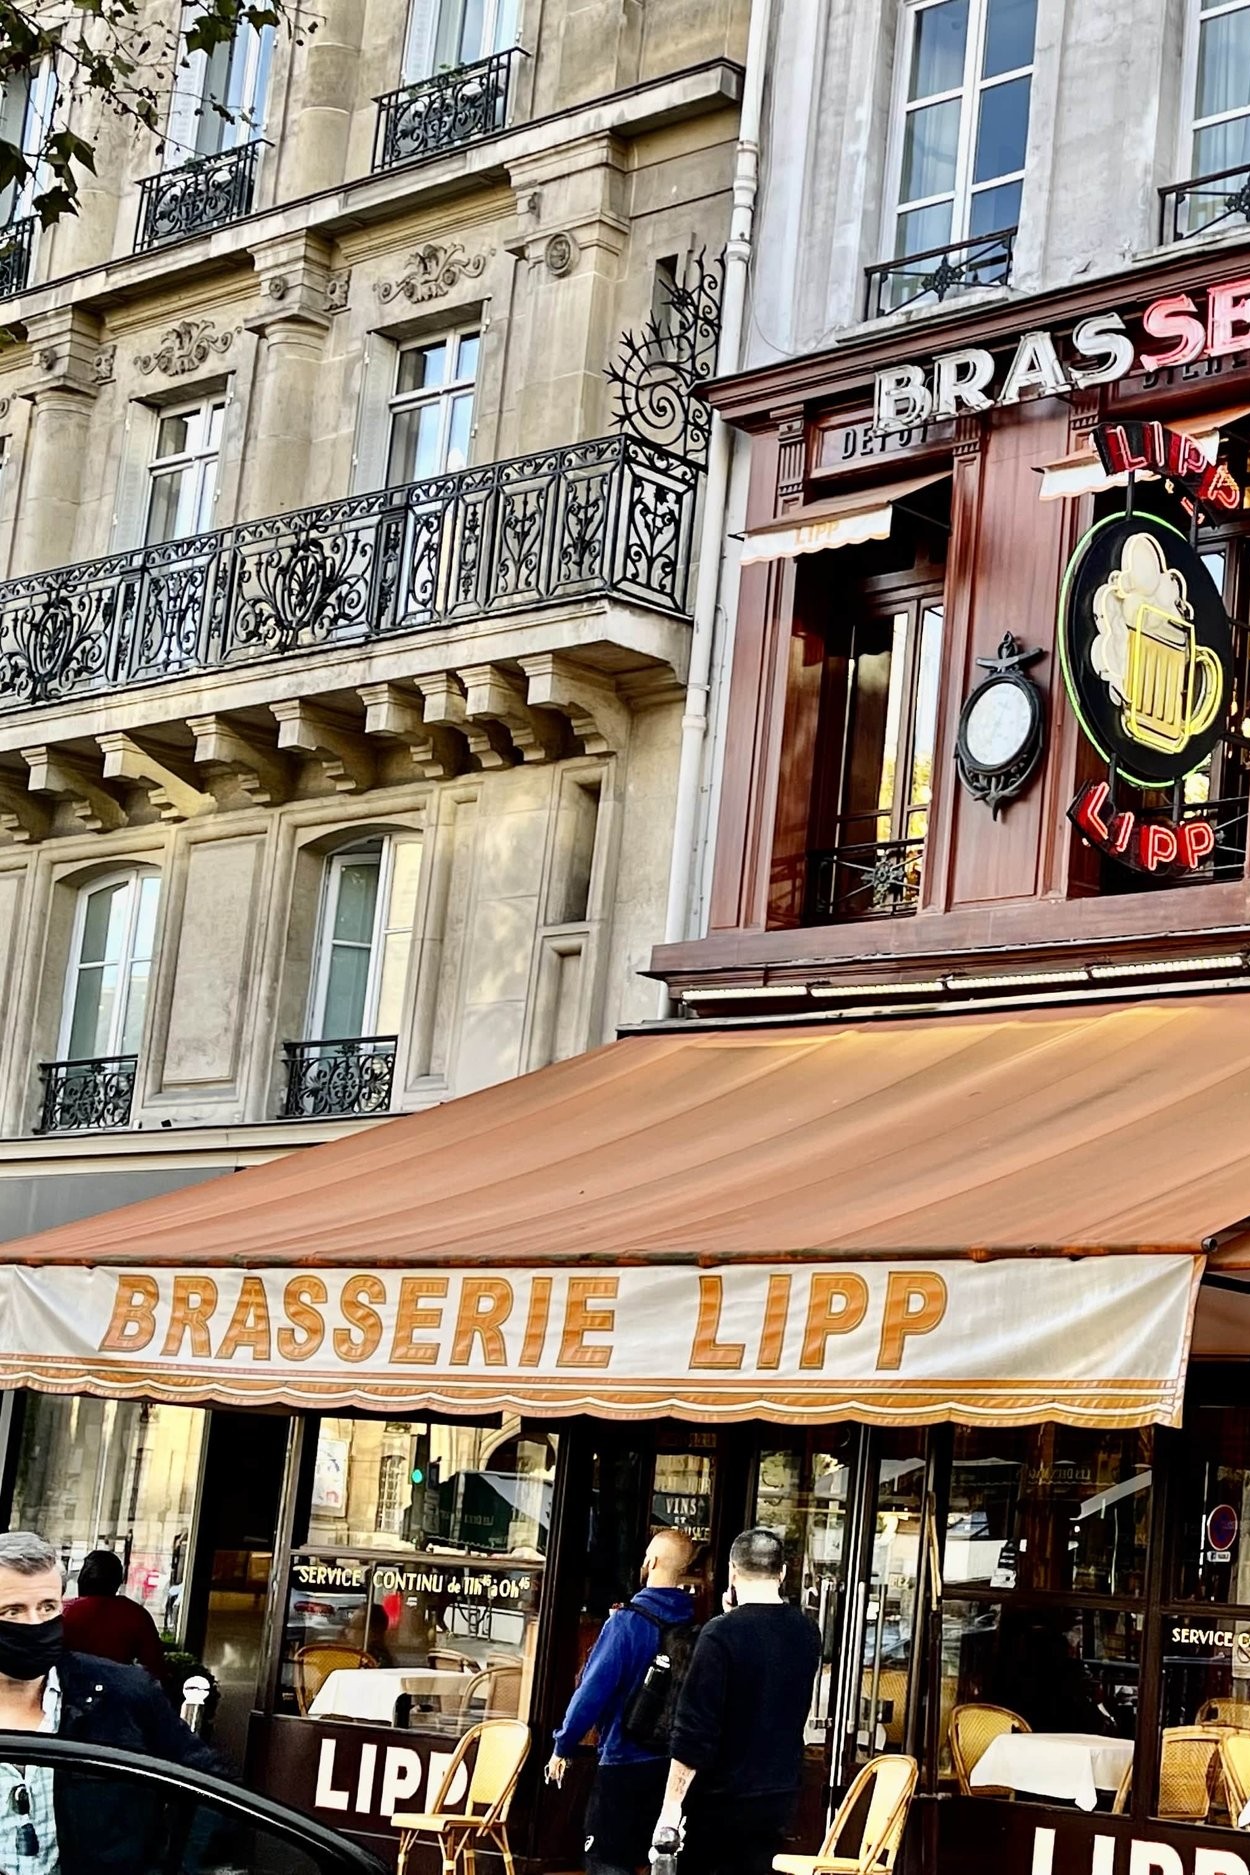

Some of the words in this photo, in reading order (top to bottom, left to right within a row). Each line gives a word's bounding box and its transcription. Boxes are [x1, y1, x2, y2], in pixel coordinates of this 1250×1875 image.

[1105, 421, 1241, 509] LIPP
[1087, 781, 1215, 871] LIPP
[98, 1273, 620, 1368] BRASSERIE
[688, 1271, 948, 1371] LIPP
[665, 1497, 697, 1516] VINS
[299, 1566, 362, 1587] SERVICE
[372, 1571, 444, 1593] CONTINU
[447, 1576, 461, 1595] de
[1172, 1628, 1233, 1647] SERVICE
[315, 1738, 468, 1817] LIPP
